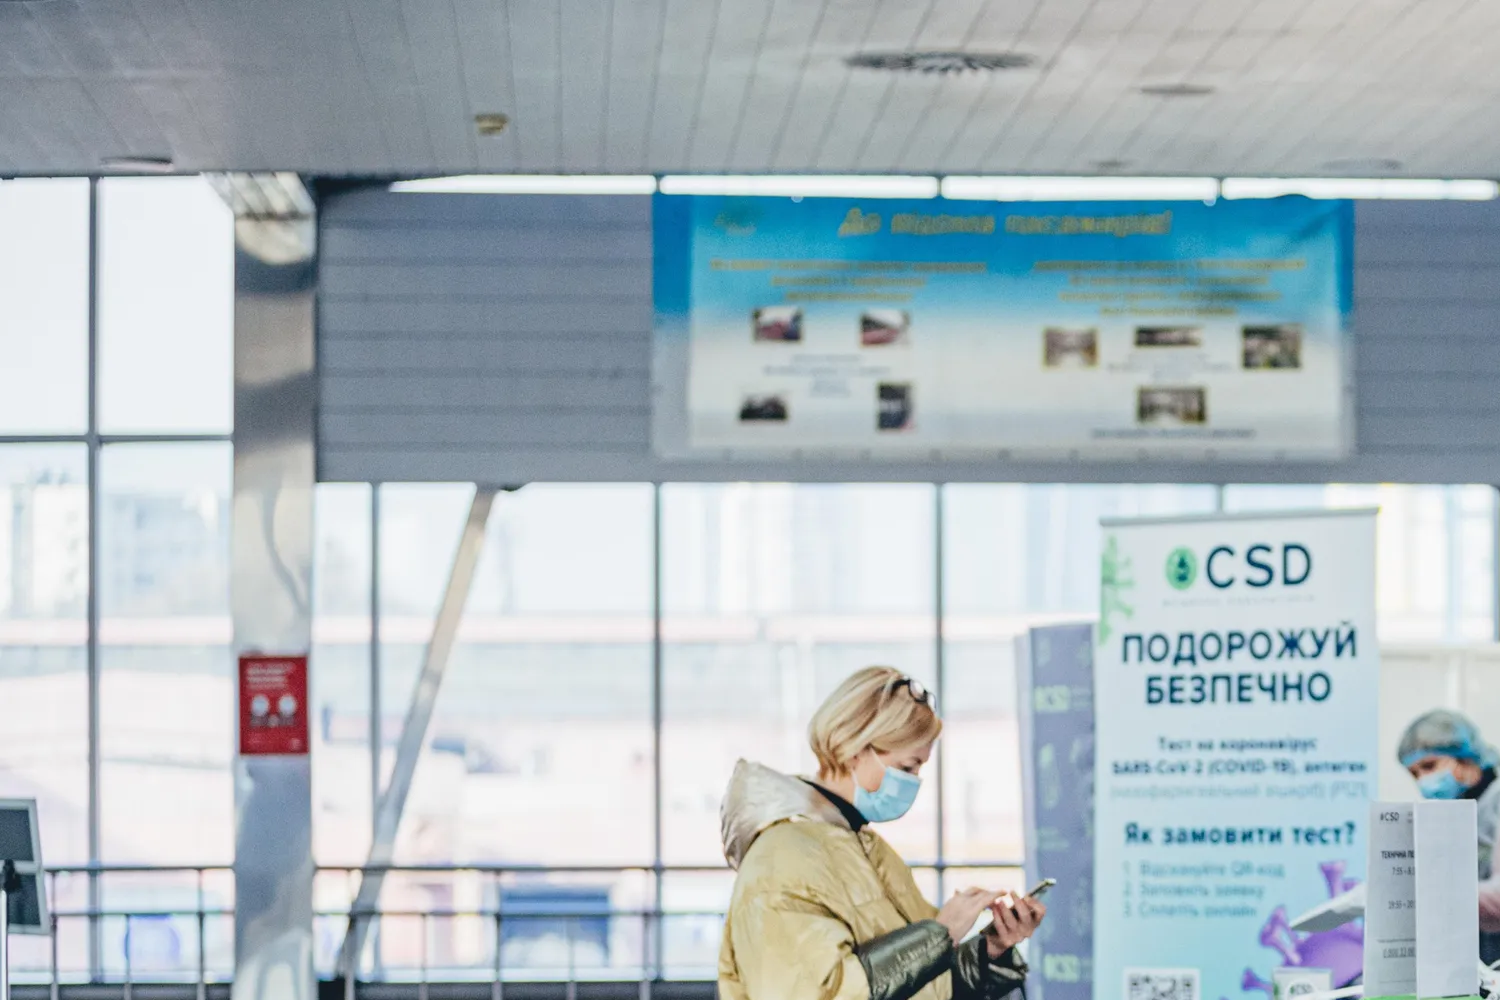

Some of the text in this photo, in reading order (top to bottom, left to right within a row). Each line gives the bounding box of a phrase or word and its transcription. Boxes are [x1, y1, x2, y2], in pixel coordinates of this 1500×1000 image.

[1206, 543, 1312, 589] CSD
[1121, 620, 1357, 667] ПОДОРОЖУЙ
[1145, 671, 1332, 705] БЕЗПЕЧНО
[1124, 820, 1357, 844] Як замовити тест?
